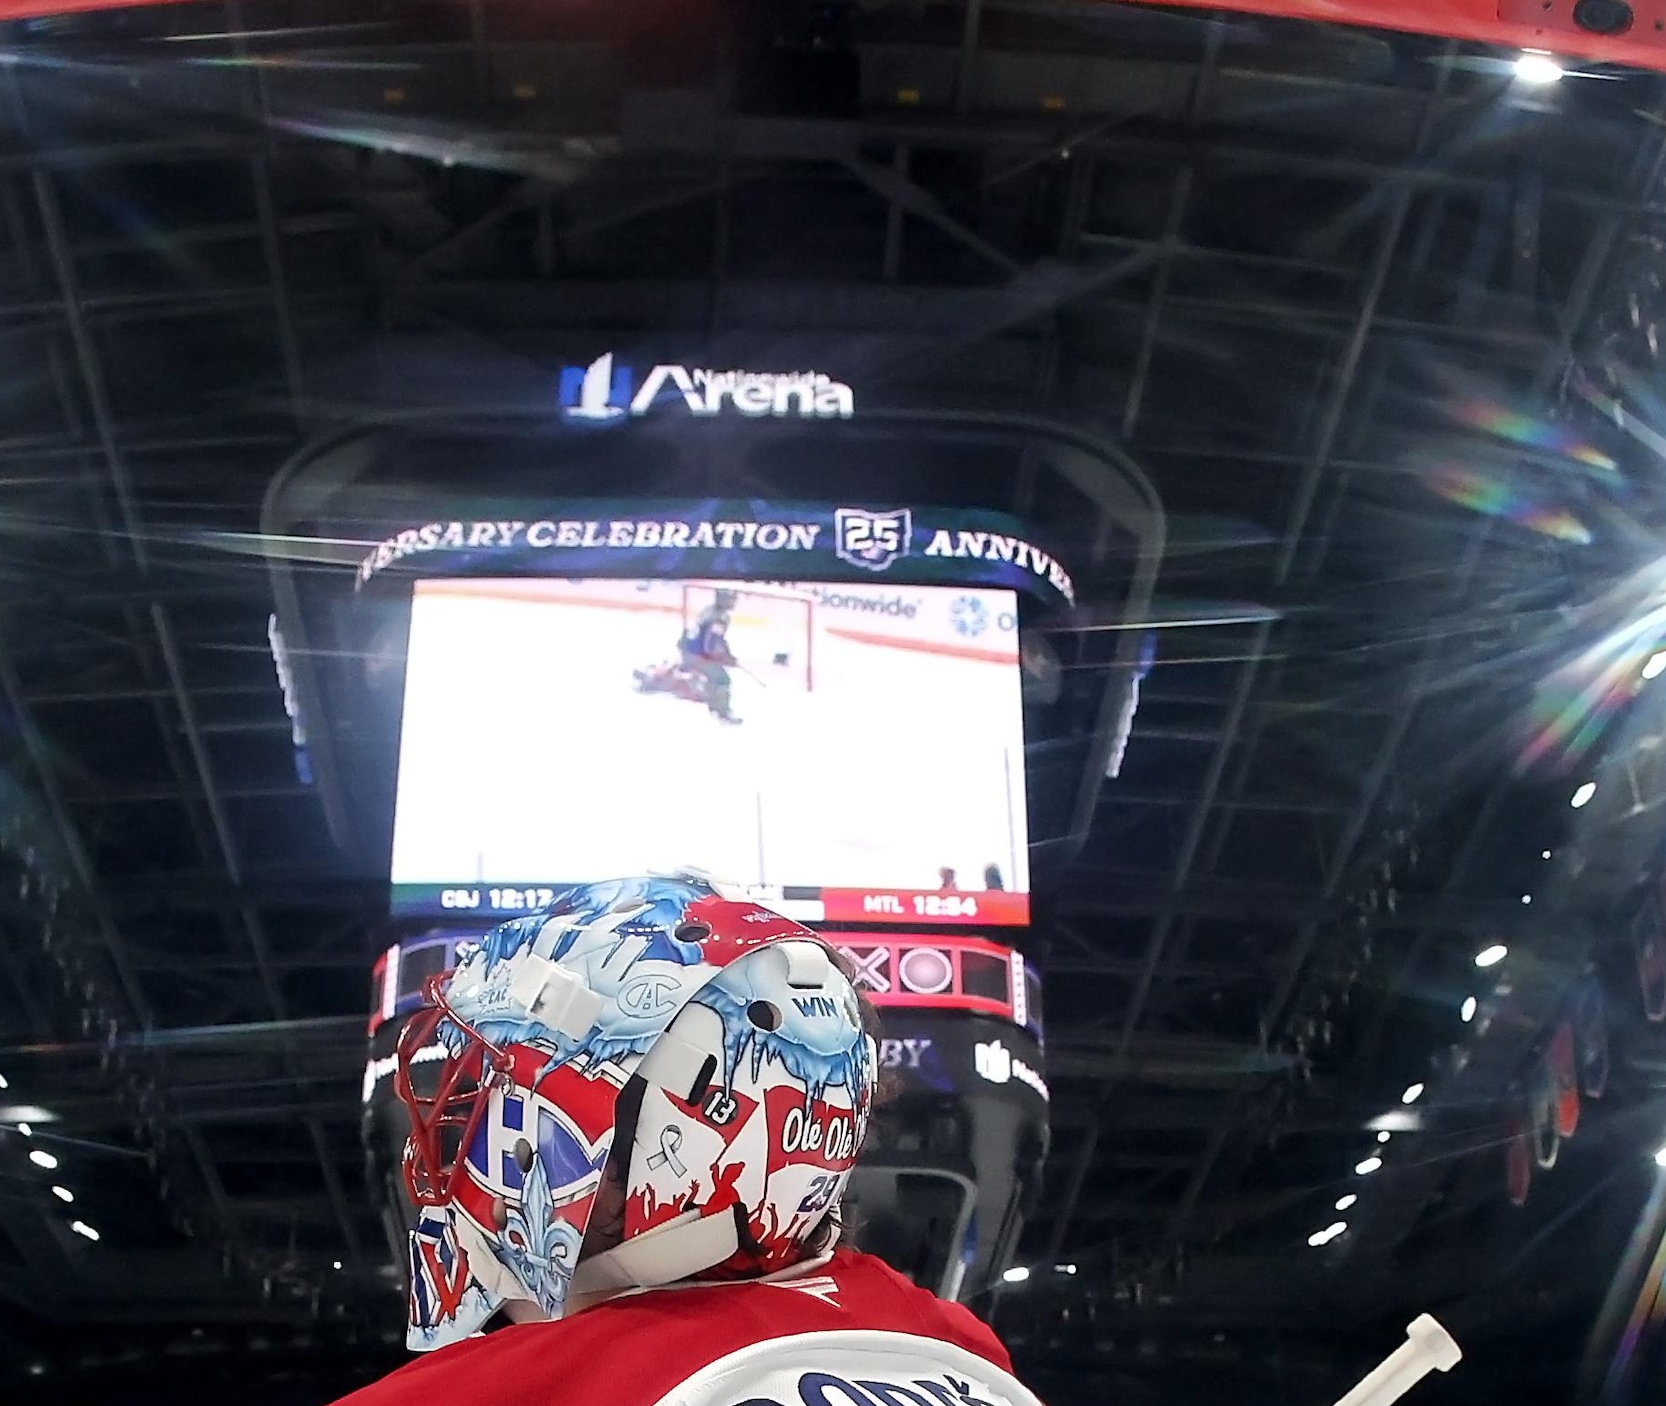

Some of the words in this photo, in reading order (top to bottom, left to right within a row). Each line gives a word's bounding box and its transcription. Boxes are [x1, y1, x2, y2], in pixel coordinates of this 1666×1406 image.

[630, 364, 855, 418] Arena
[525, 520, 821, 551] CELEBRATION
[844, 516, 901, 551] 25
[863, 894, 905, 914] MTL
[792, 997, 839, 1018] WIN
[702, 1090, 738, 1126] 13
[782, 1107, 824, 1154] Olé
